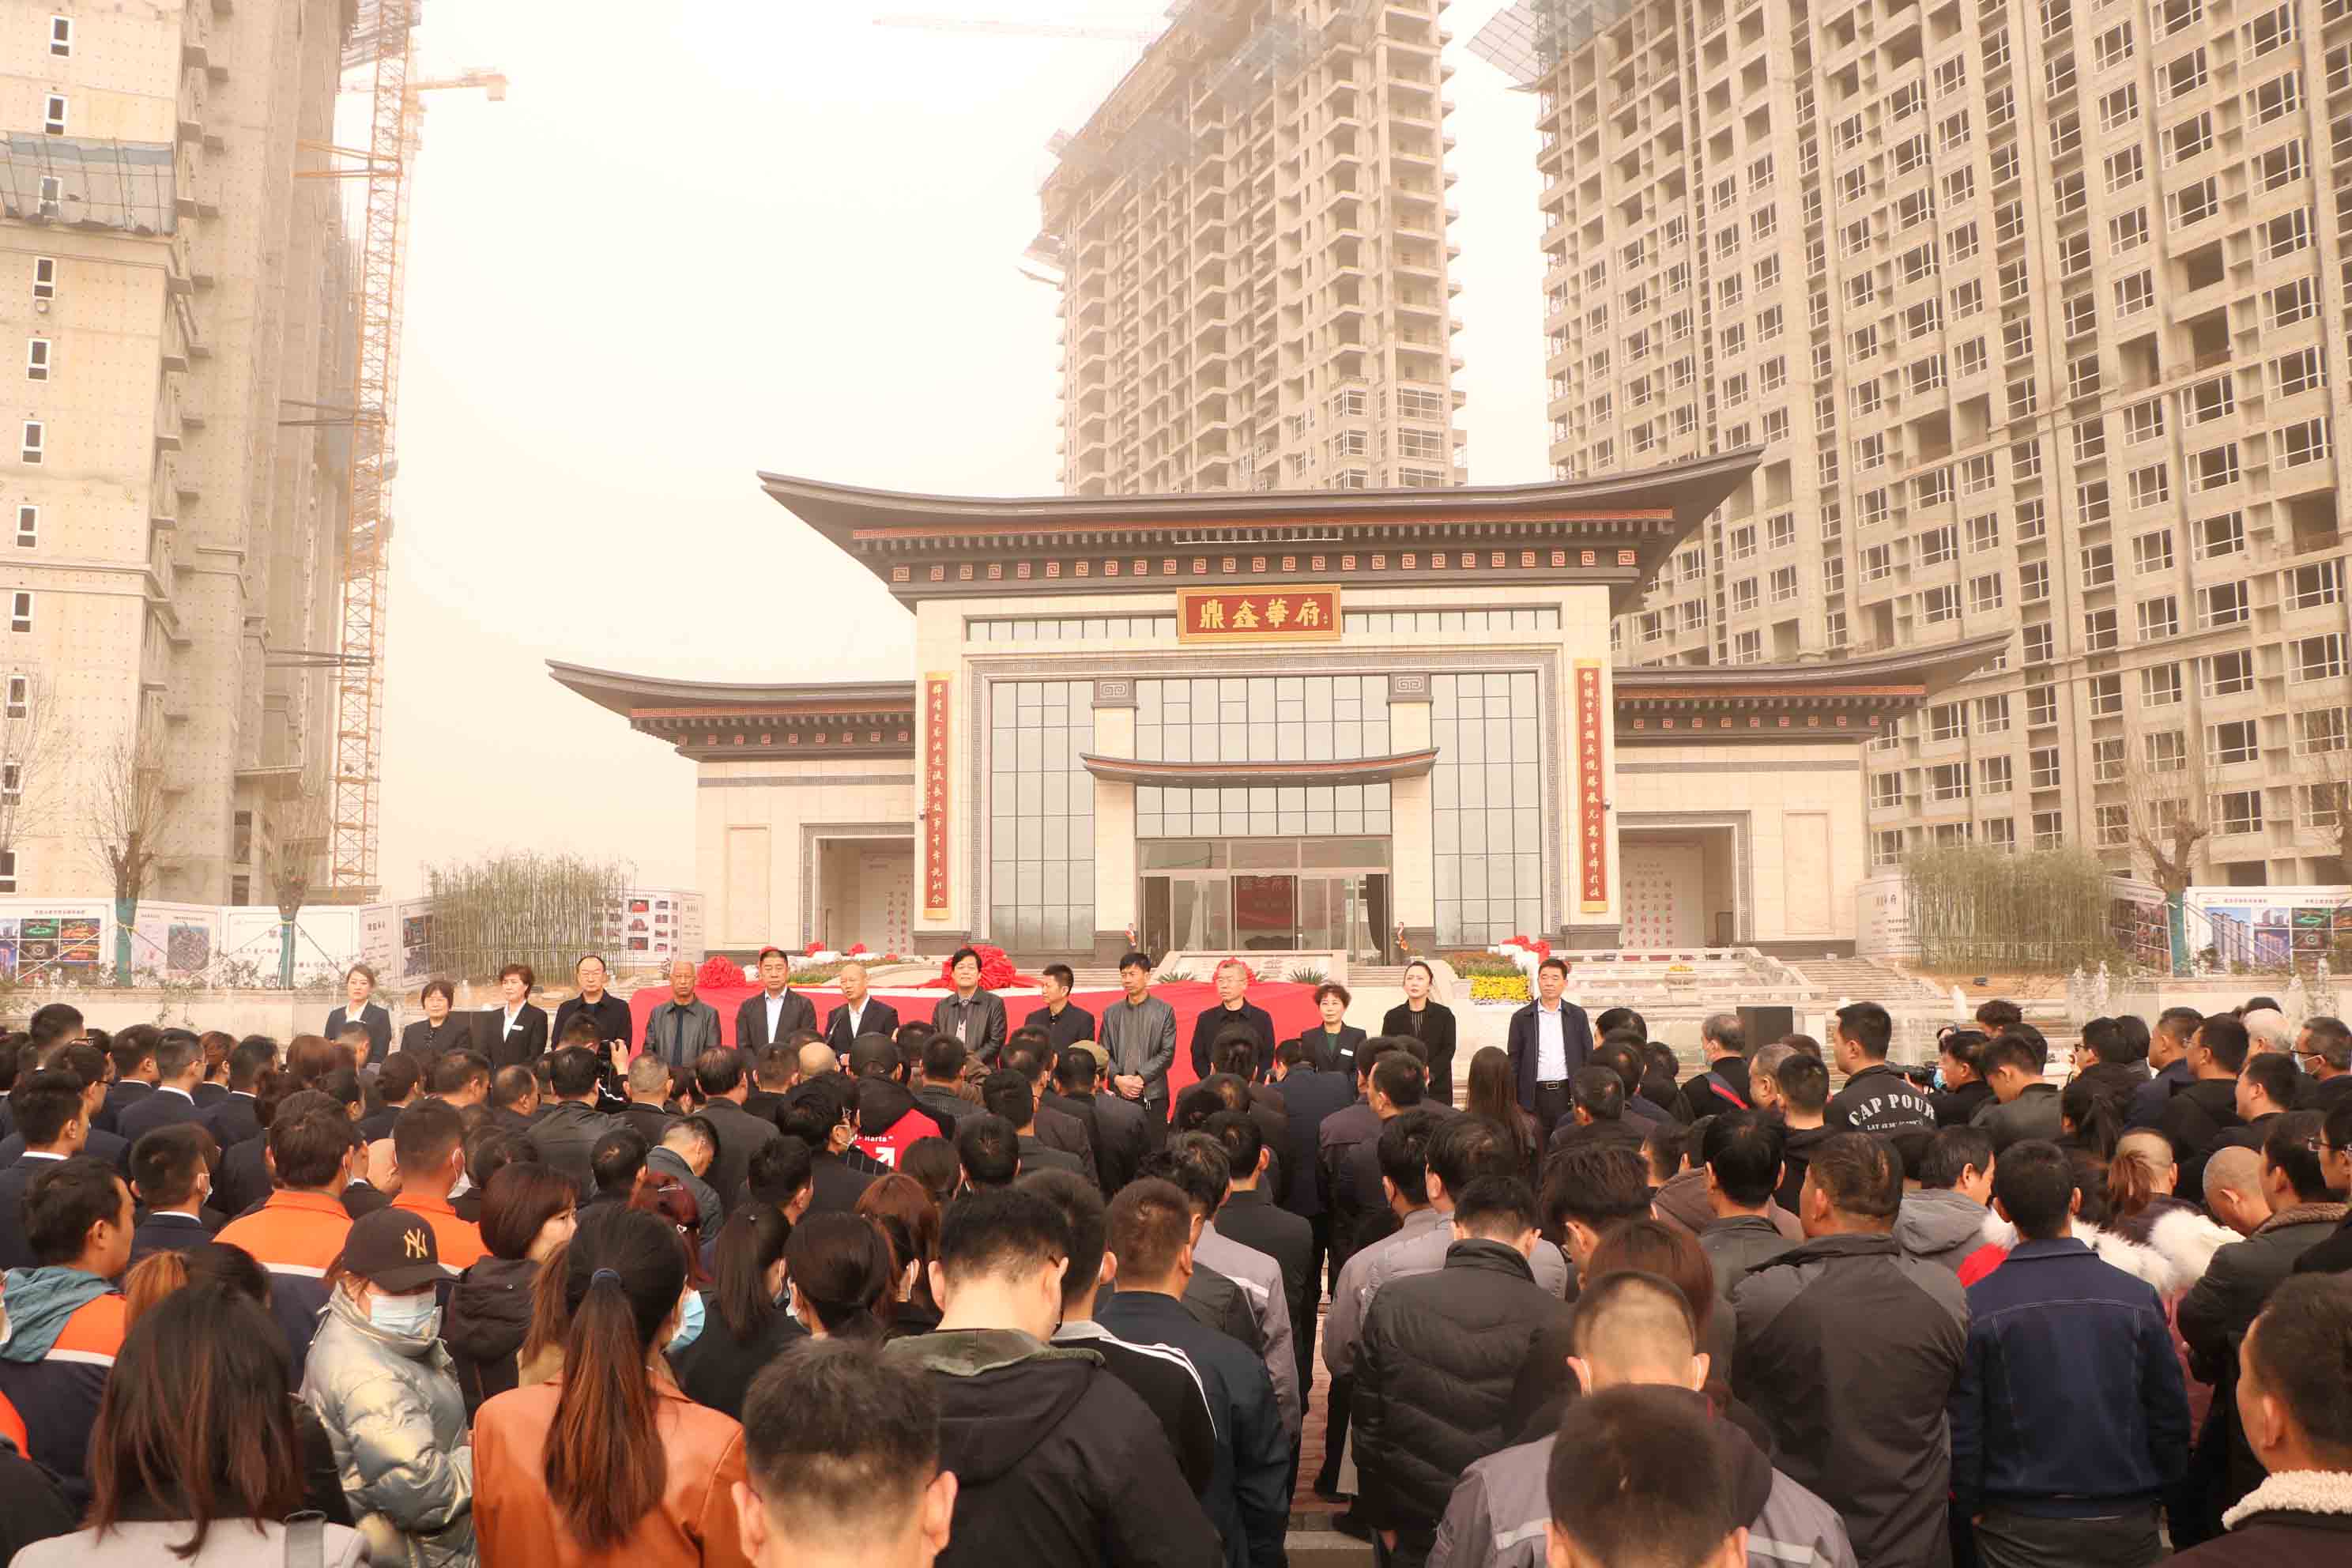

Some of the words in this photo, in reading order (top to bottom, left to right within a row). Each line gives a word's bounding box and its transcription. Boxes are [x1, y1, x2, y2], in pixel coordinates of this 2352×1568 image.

[1849, 1097, 1882, 1126] CAP
[1888, 1094, 1935, 1120] POUR
[401, 1227, 428, 1259] NY
